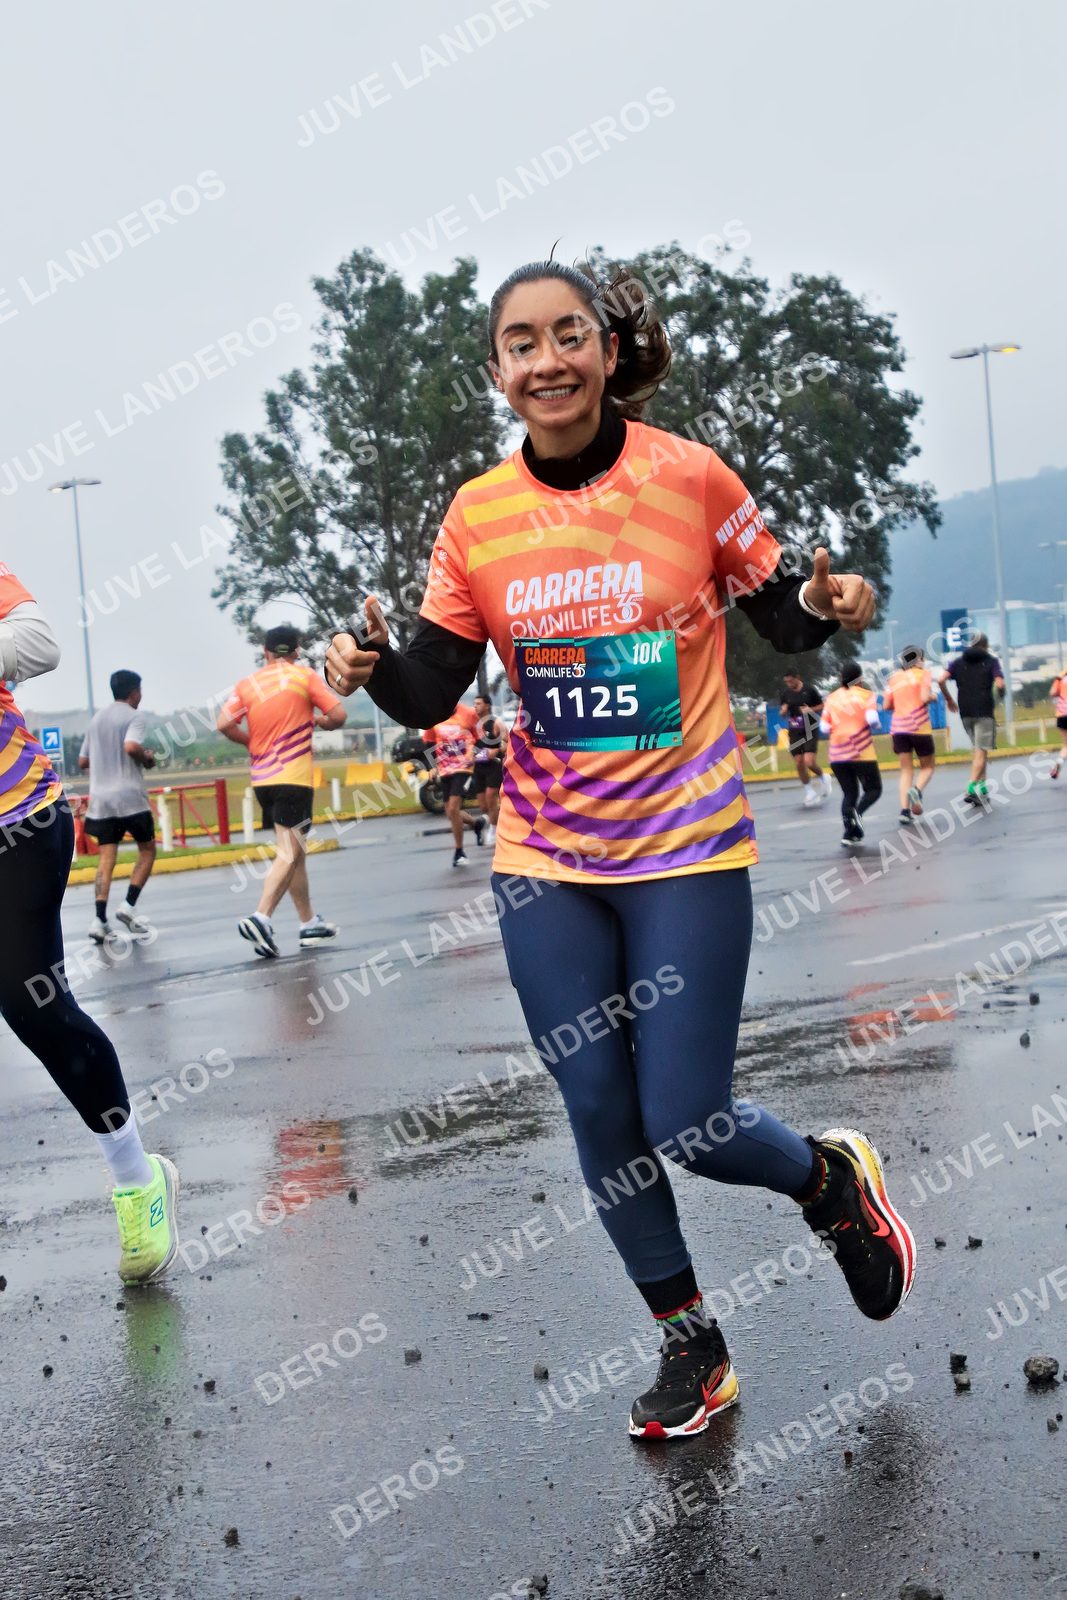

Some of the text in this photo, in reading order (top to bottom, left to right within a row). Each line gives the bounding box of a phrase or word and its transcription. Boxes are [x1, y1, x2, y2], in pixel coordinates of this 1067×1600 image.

[505, 560, 643, 616] CARRERA
[509, 605, 612, 638] OMNILIFE
[946, 627, 962, 648] E
[524, 647, 586, 665] CARRERA
[632, 640, 664, 665] 10K
[526, 666, 572, 678] OMNILIFE
[545, 684, 639, 718] 1125
